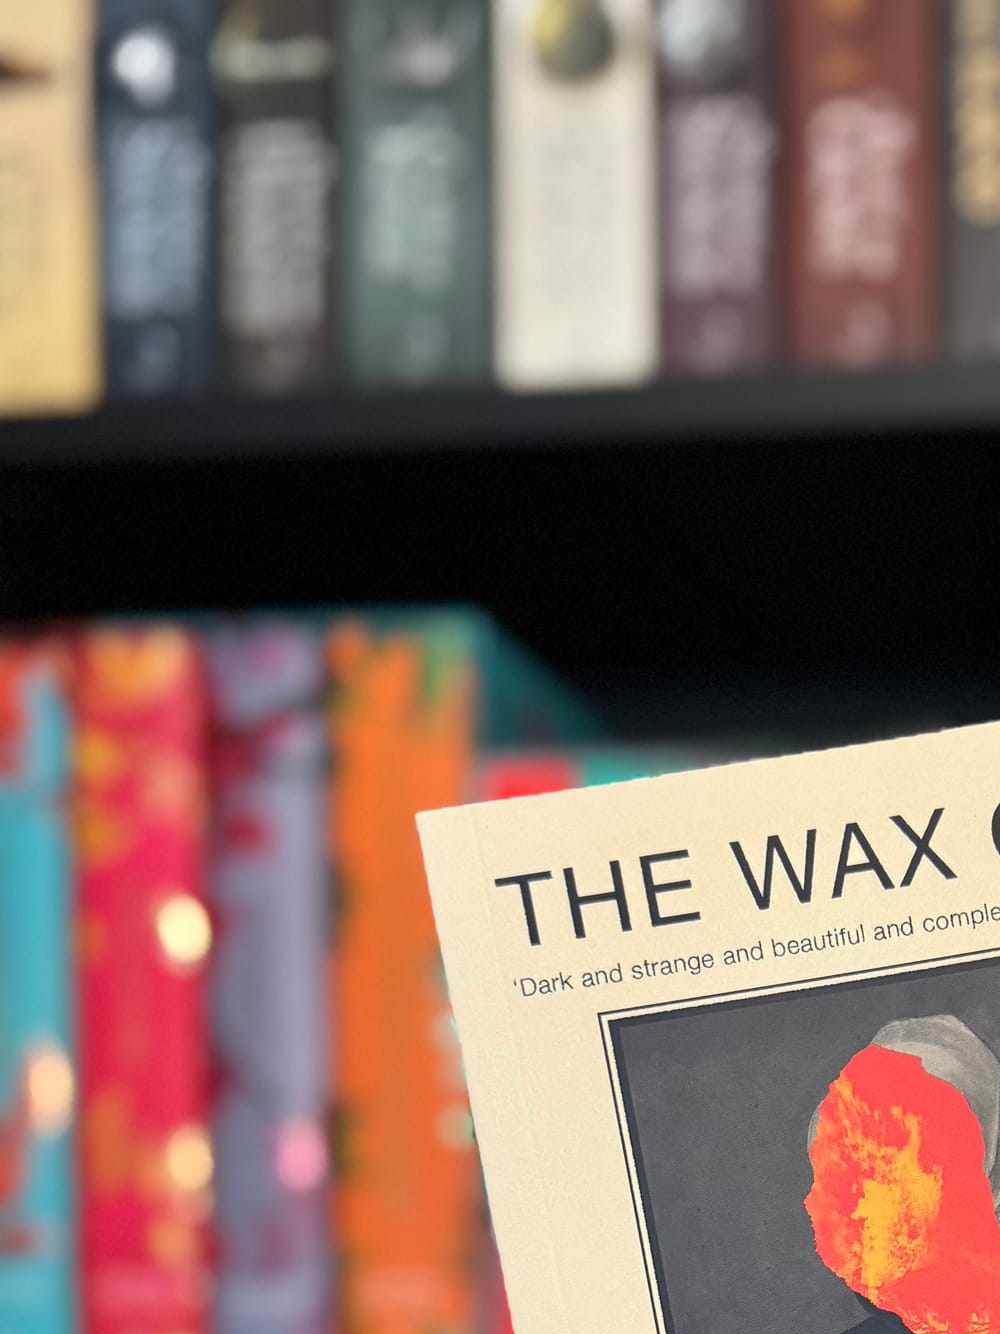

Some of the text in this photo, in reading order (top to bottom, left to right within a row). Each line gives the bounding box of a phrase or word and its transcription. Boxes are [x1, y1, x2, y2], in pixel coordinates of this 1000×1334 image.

[494, 849, 701, 946] THE
[730, 808, 958, 911] WAX
[513, 972, 574, 998] ‘Dark
[582, 964, 623, 989] and
[632, 950, 715, 980] strange
[723, 941, 764, 966] and
[772, 924, 865, 958] beautiful
[874, 916, 914, 941] and
